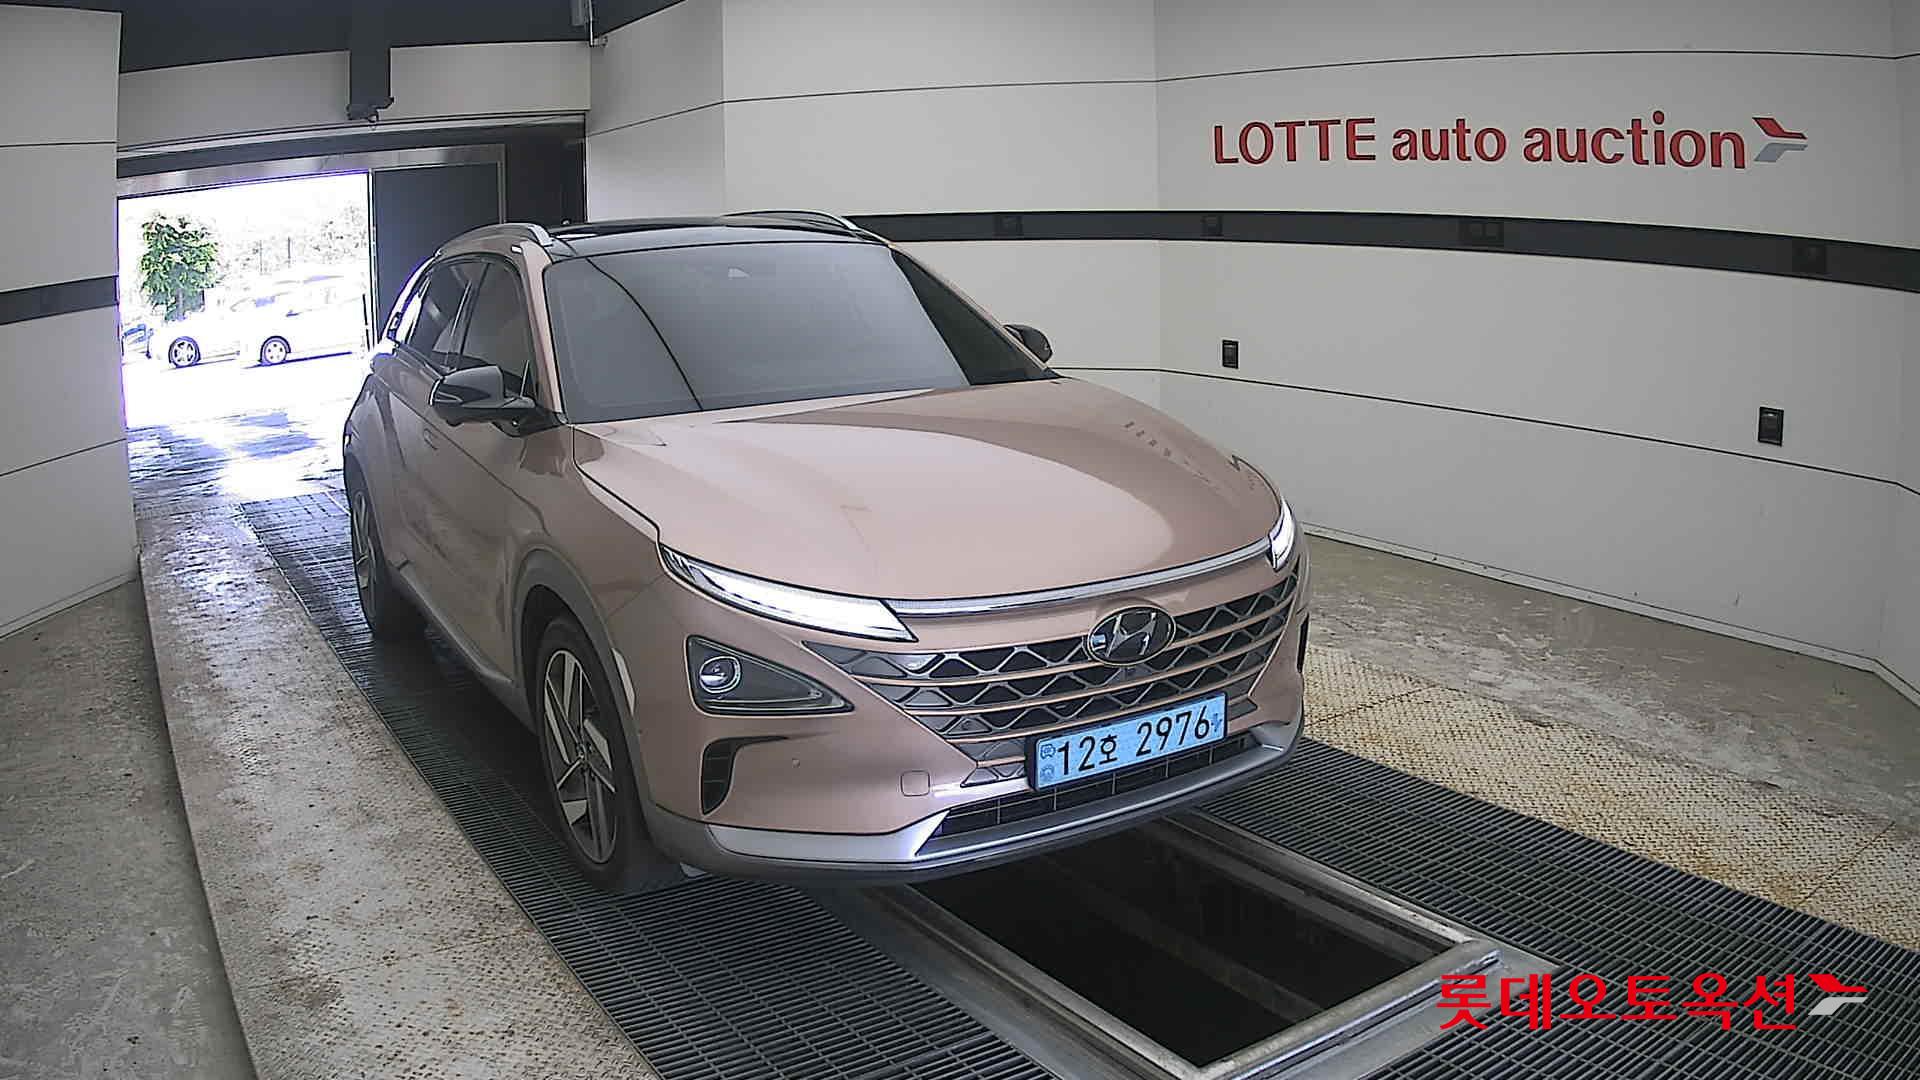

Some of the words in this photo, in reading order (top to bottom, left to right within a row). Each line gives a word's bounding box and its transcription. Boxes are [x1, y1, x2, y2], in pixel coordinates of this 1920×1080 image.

[1213, 117, 1377, 165] LOTTE
[1392, 118, 1507, 163] auto
[1523, 110, 1746, 169] auction
[1057, 735, 1118, 775] 12호
[1135, 705, 1210, 757] 2976
